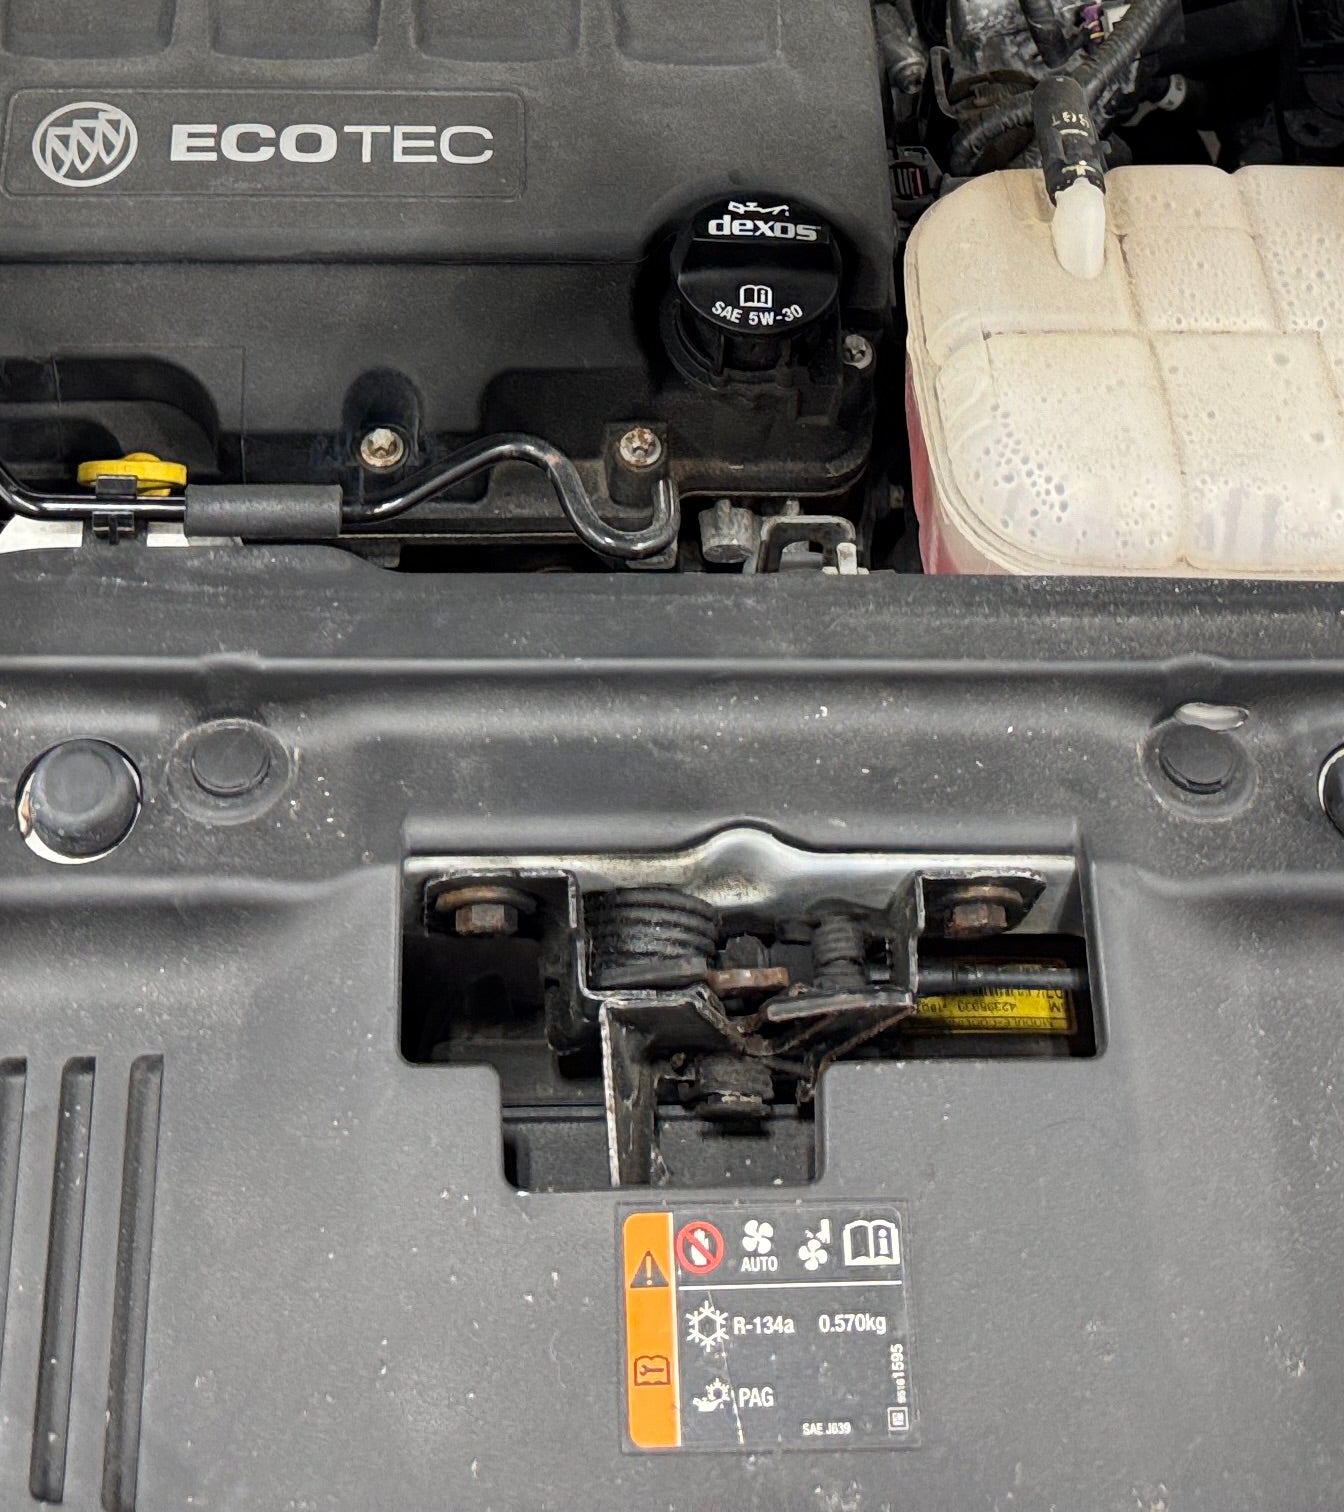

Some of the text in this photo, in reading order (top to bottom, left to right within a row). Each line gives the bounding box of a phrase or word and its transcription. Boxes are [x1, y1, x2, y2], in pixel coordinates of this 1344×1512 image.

[170, 123, 494, 164] ECOTEC
[708, 214, 818, 241] dexos
[711, 301, 803, 326] SAE 5W-30
[741, 1255, 778, 1272] AUTO
[733, 1314, 886, 1335] R-134a 0.570kg
[739, 1387, 774, 1407] PAG
[802, 1422, 823, 1435] SAE
